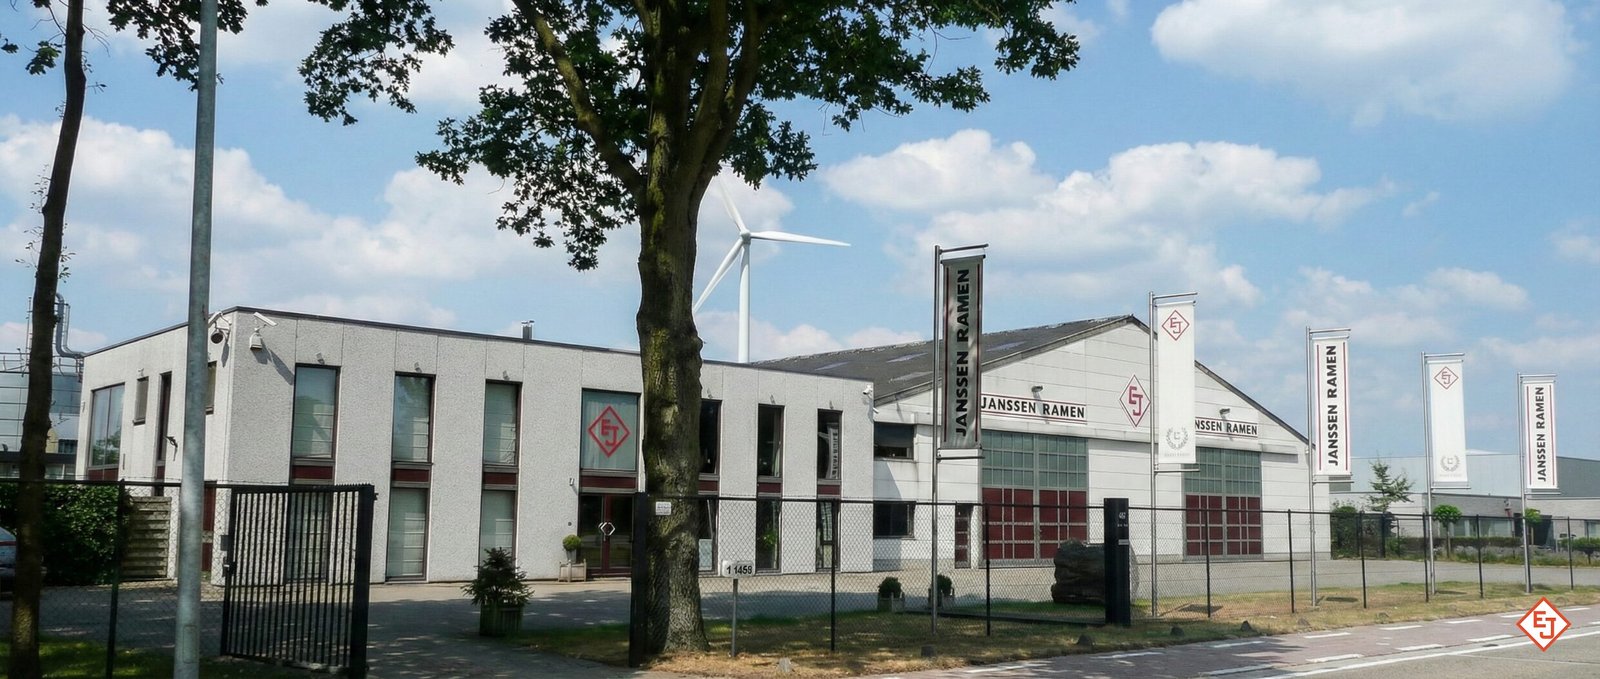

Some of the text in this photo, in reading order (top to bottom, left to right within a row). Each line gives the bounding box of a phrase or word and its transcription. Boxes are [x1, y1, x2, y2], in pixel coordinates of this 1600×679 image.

[955, 269, 970, 437] JANSSEN RAMEN
[981, 397, 1085, 418] JANSSEN RAMEN
[1195, 419, 1258, 435] NSSEN RAMEN
[1326, 345, 1339, 466] JANSSEN RAMEN
[1535, 387, 1547, 482] JANSSEN RAMEN
[726, 565, 731, 574] 1
